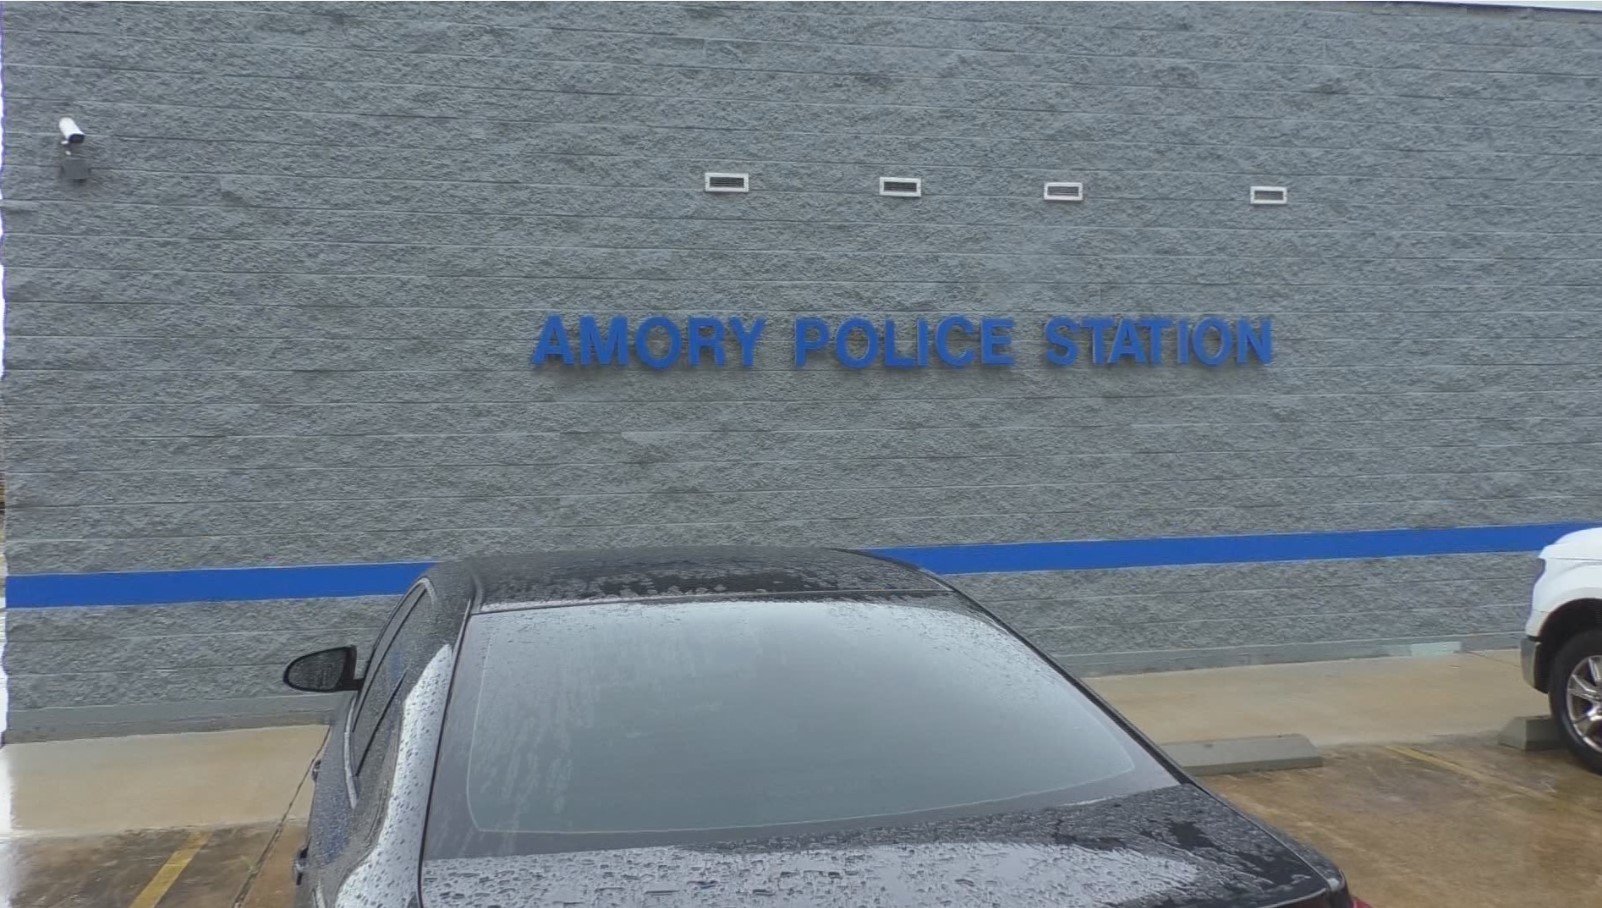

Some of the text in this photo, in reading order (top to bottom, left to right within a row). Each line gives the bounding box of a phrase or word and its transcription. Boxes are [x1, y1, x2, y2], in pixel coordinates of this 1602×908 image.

[533, 315, 1273, 369] AMORY POLICE STATION
